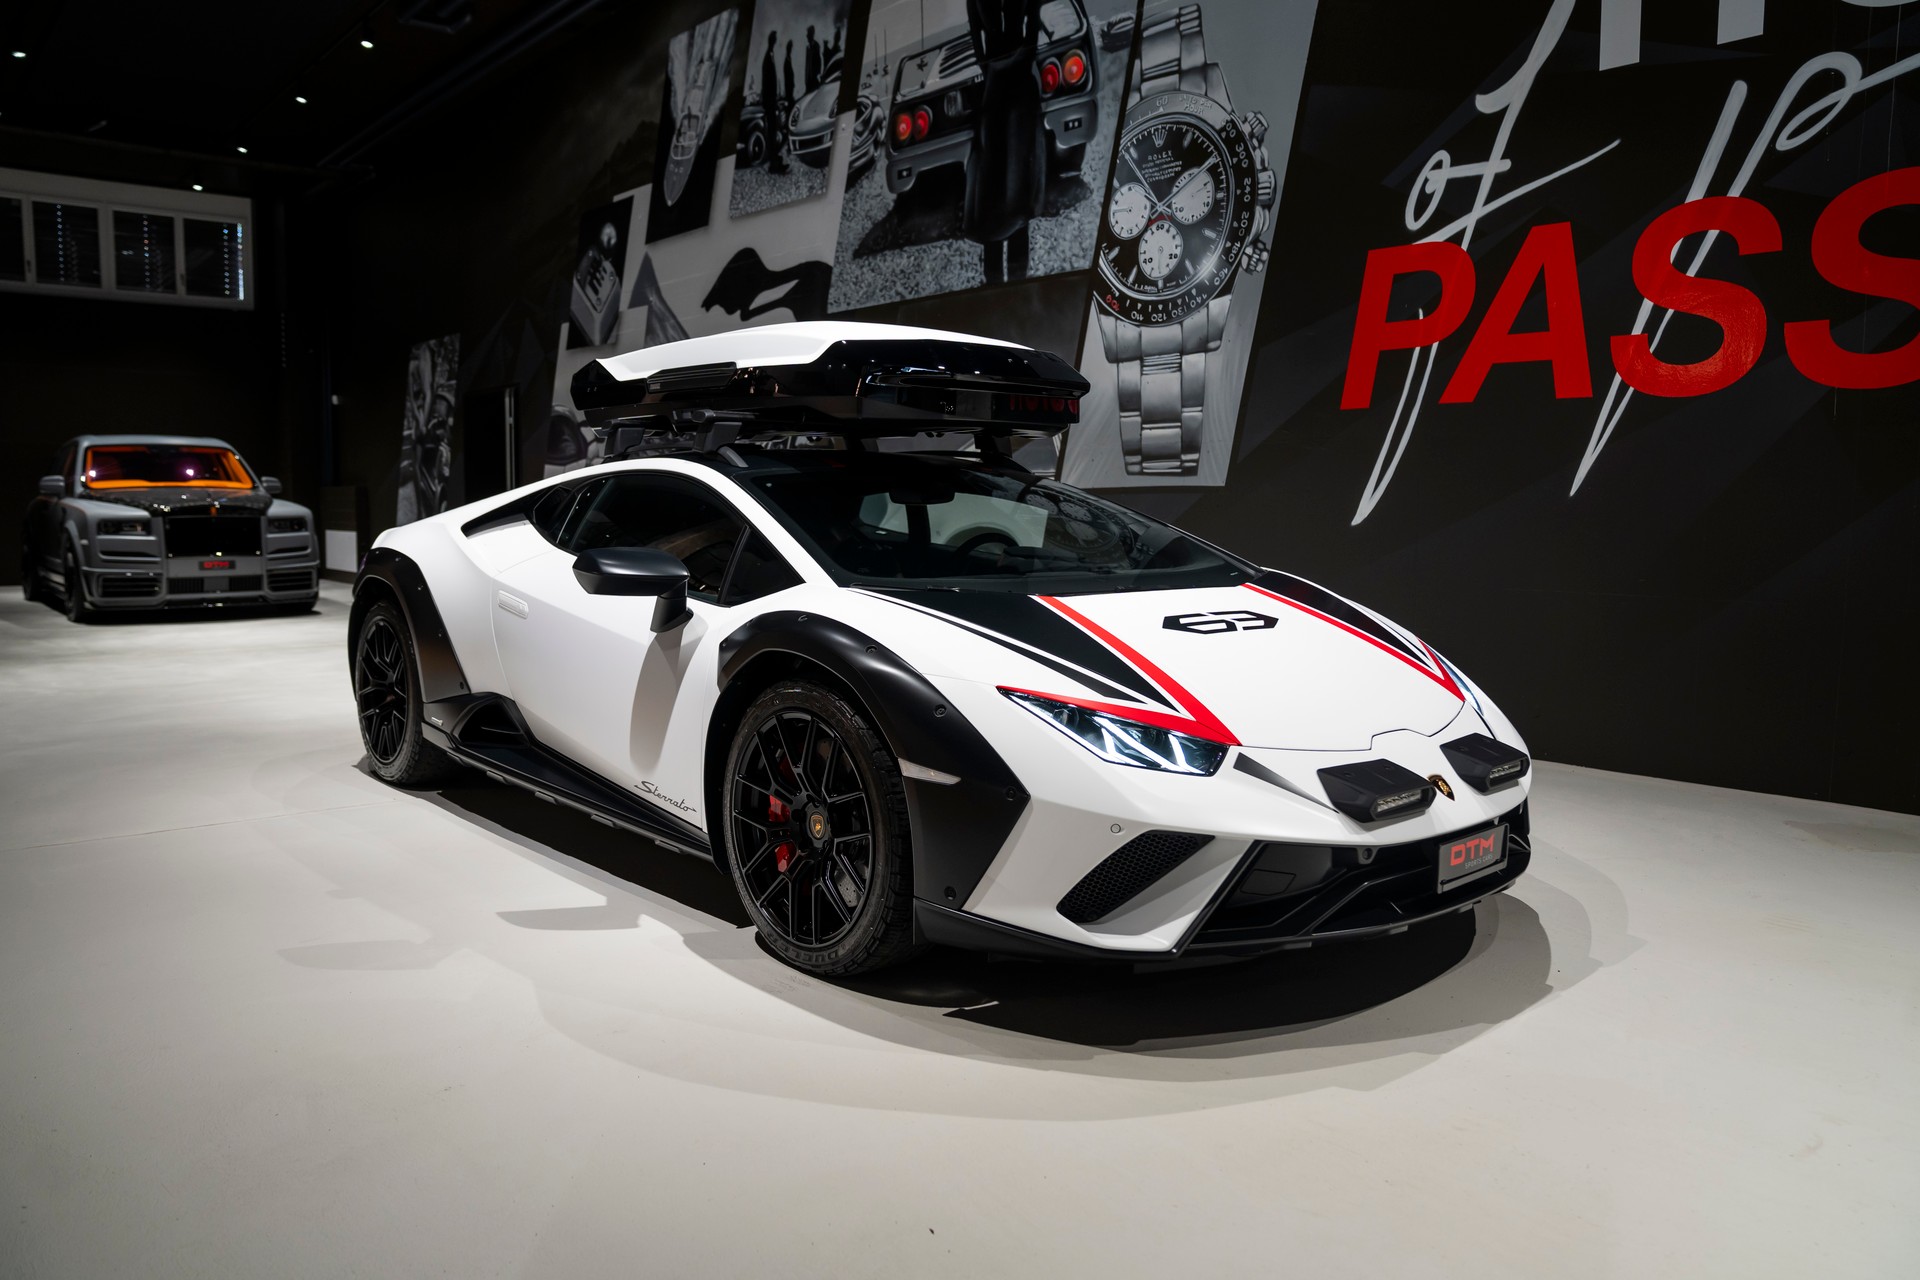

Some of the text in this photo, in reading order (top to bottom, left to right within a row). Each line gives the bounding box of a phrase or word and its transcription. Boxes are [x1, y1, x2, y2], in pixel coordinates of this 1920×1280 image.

[1147, 150, 1173, 161] ROLEX
[1235, 142, 1248, 167] 300
[1243, 177, 1252, 202] 240
[1237, 210, 1249, 236] 200
[1227, 240, 1241, 262] 180
[1213, 266, 1230, 285] 160
[1340, 166, 1920, 410] PASS
[1131, 311, 1144, 321] 110
[1151, 313, 1167, 322] 120
[1171, 305, 1187, 318] 130
[1162, 610, 1279, 634] 63
[634, 780, 697, 813] Sterrato
[1450, 832, 1495, 866] DTM
